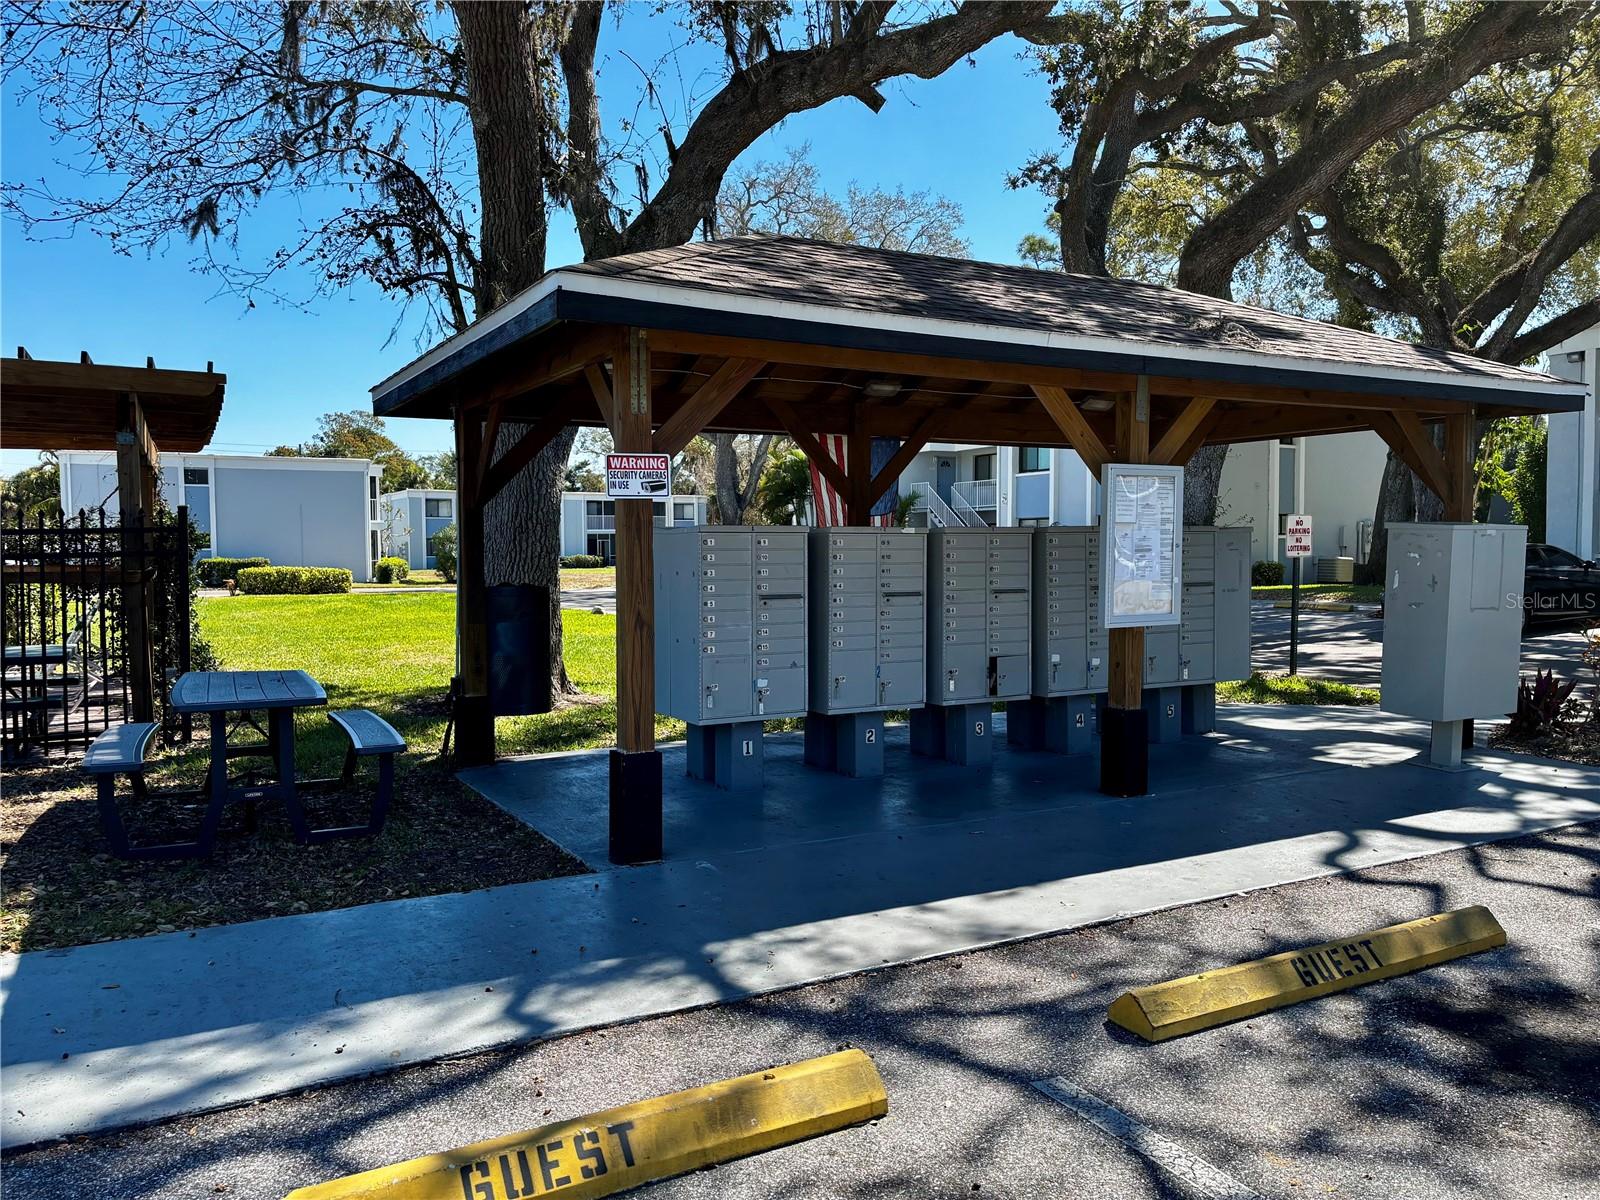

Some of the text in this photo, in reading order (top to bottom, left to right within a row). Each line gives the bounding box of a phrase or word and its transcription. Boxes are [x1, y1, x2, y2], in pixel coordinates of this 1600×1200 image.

[609, 457, 666, 469] WARNING
[609, 471, 667, 480] SECURITY CAMERAS
[609, 481, 630, 490] IN USE
[1167, 705, 1174, 718] 5
[1076, 714, 1084, 726] 4
[976, 722, 983, 736] 3
[867, 729, 874, 743] 2
[744, 741, 751, 755] 1
[1290, 940, 1383, 987] GUEST
[460, 1121, 635, 1200] GUEST
